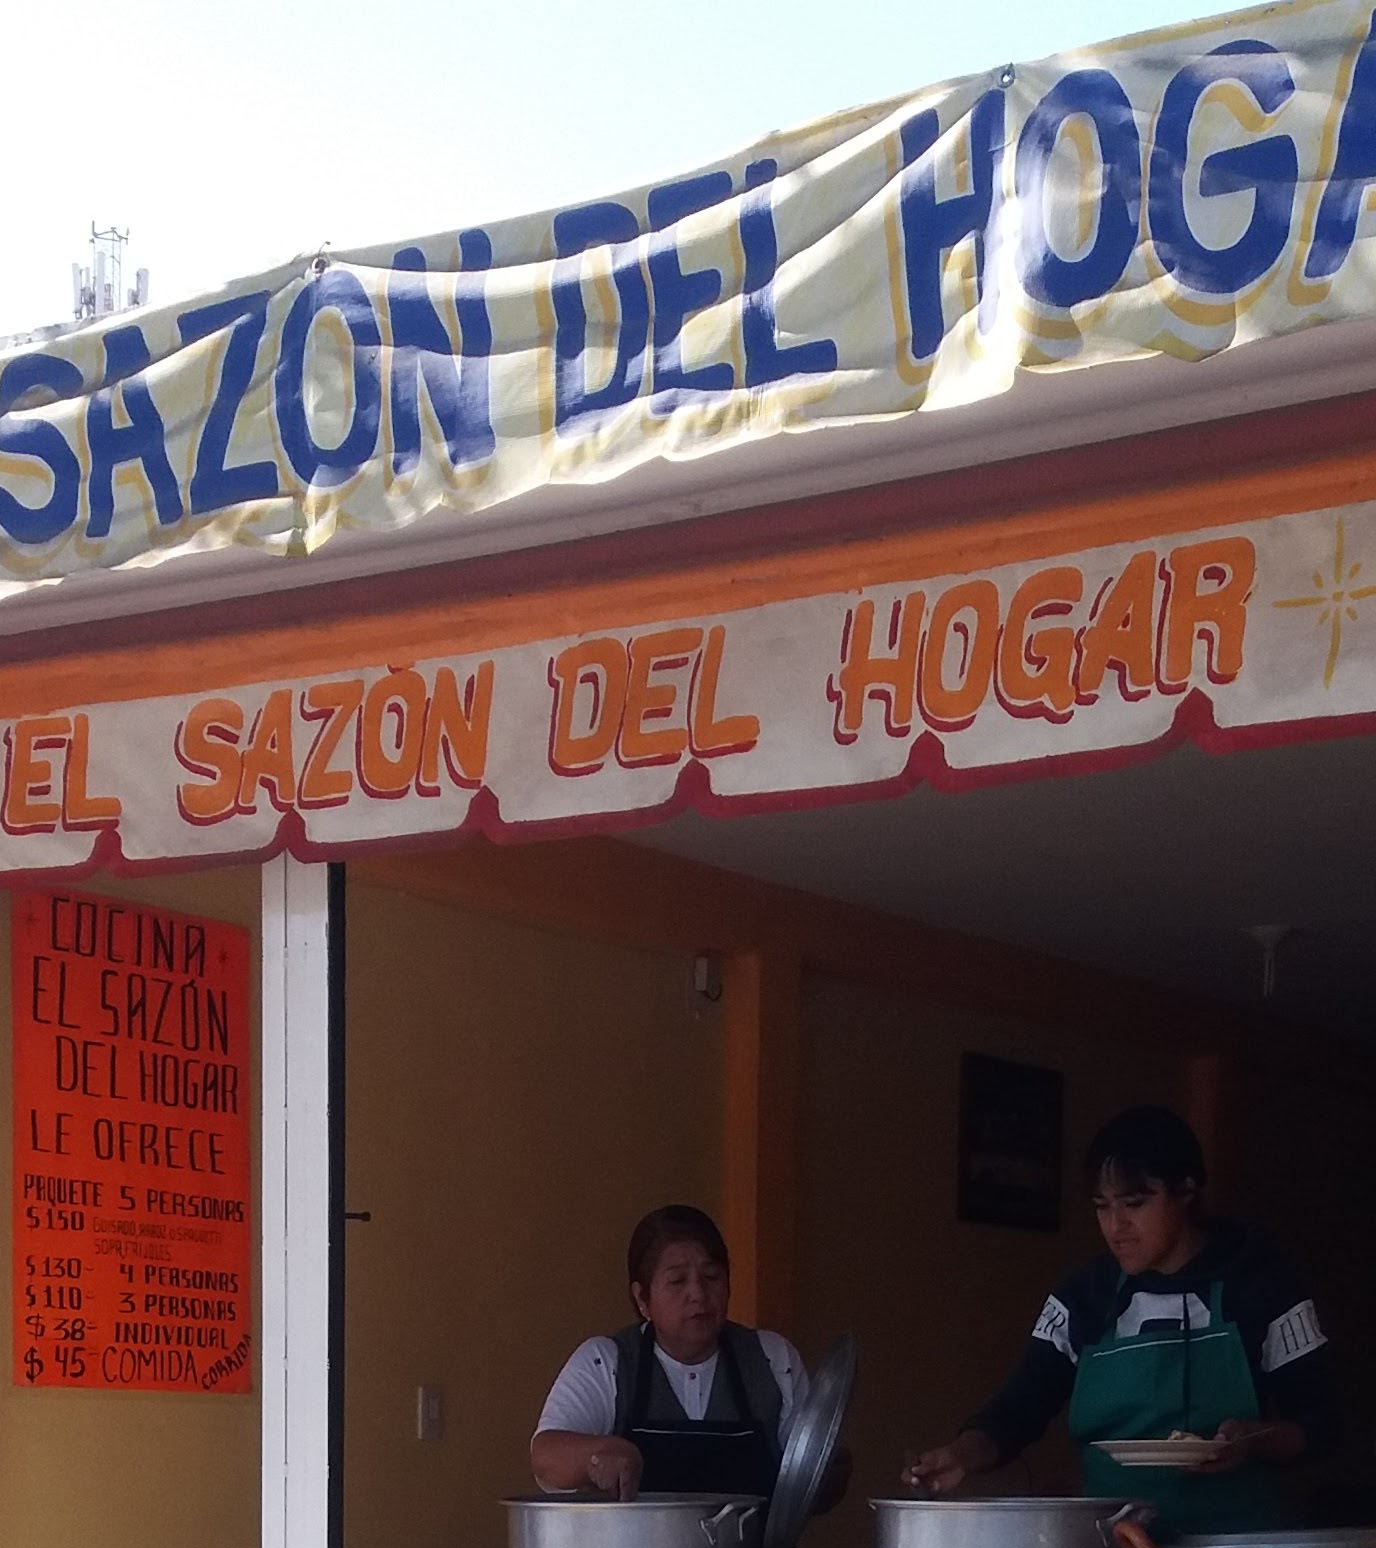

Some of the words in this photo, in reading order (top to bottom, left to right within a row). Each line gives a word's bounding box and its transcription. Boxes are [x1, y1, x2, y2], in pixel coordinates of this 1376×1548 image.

[552, 160, 838, 440] DEL
[1, 712, 121, 834] EL
[549, 624, 760, 778] DEL
[826, 535, 1258, 745] HOGAR
[51, 895, 205, 977] COCINA
[32, 955, 81, 1029] EL
[100, 968, 228, 1056] SAZÓN
[55, 1035, 128, 1099] DEL
[139, 1050, 238, 1115] HOGAR
[30, 1109, 73, 1155] LE
[93, 1117, 226, 1175] OFRECE
[24, 1173, 104, 1207] PAQUETE
[118, 1185, 137, 1212] 5
[146, 1188, 245, 1223] PERSONAS
[118, 1292, 137, 1314] 3
[144, 1294, 237, 1322] PERSONAS
[119, 1264, 134, 1284] 4
[144, 1264, 239, 1294] PERSONAS
[102, 1345, 198, 1385] COMIDA
[201, 1334, 252, 1390] CORRIDA
[114, 1321, 229, 1350] INDIVIDUAL
